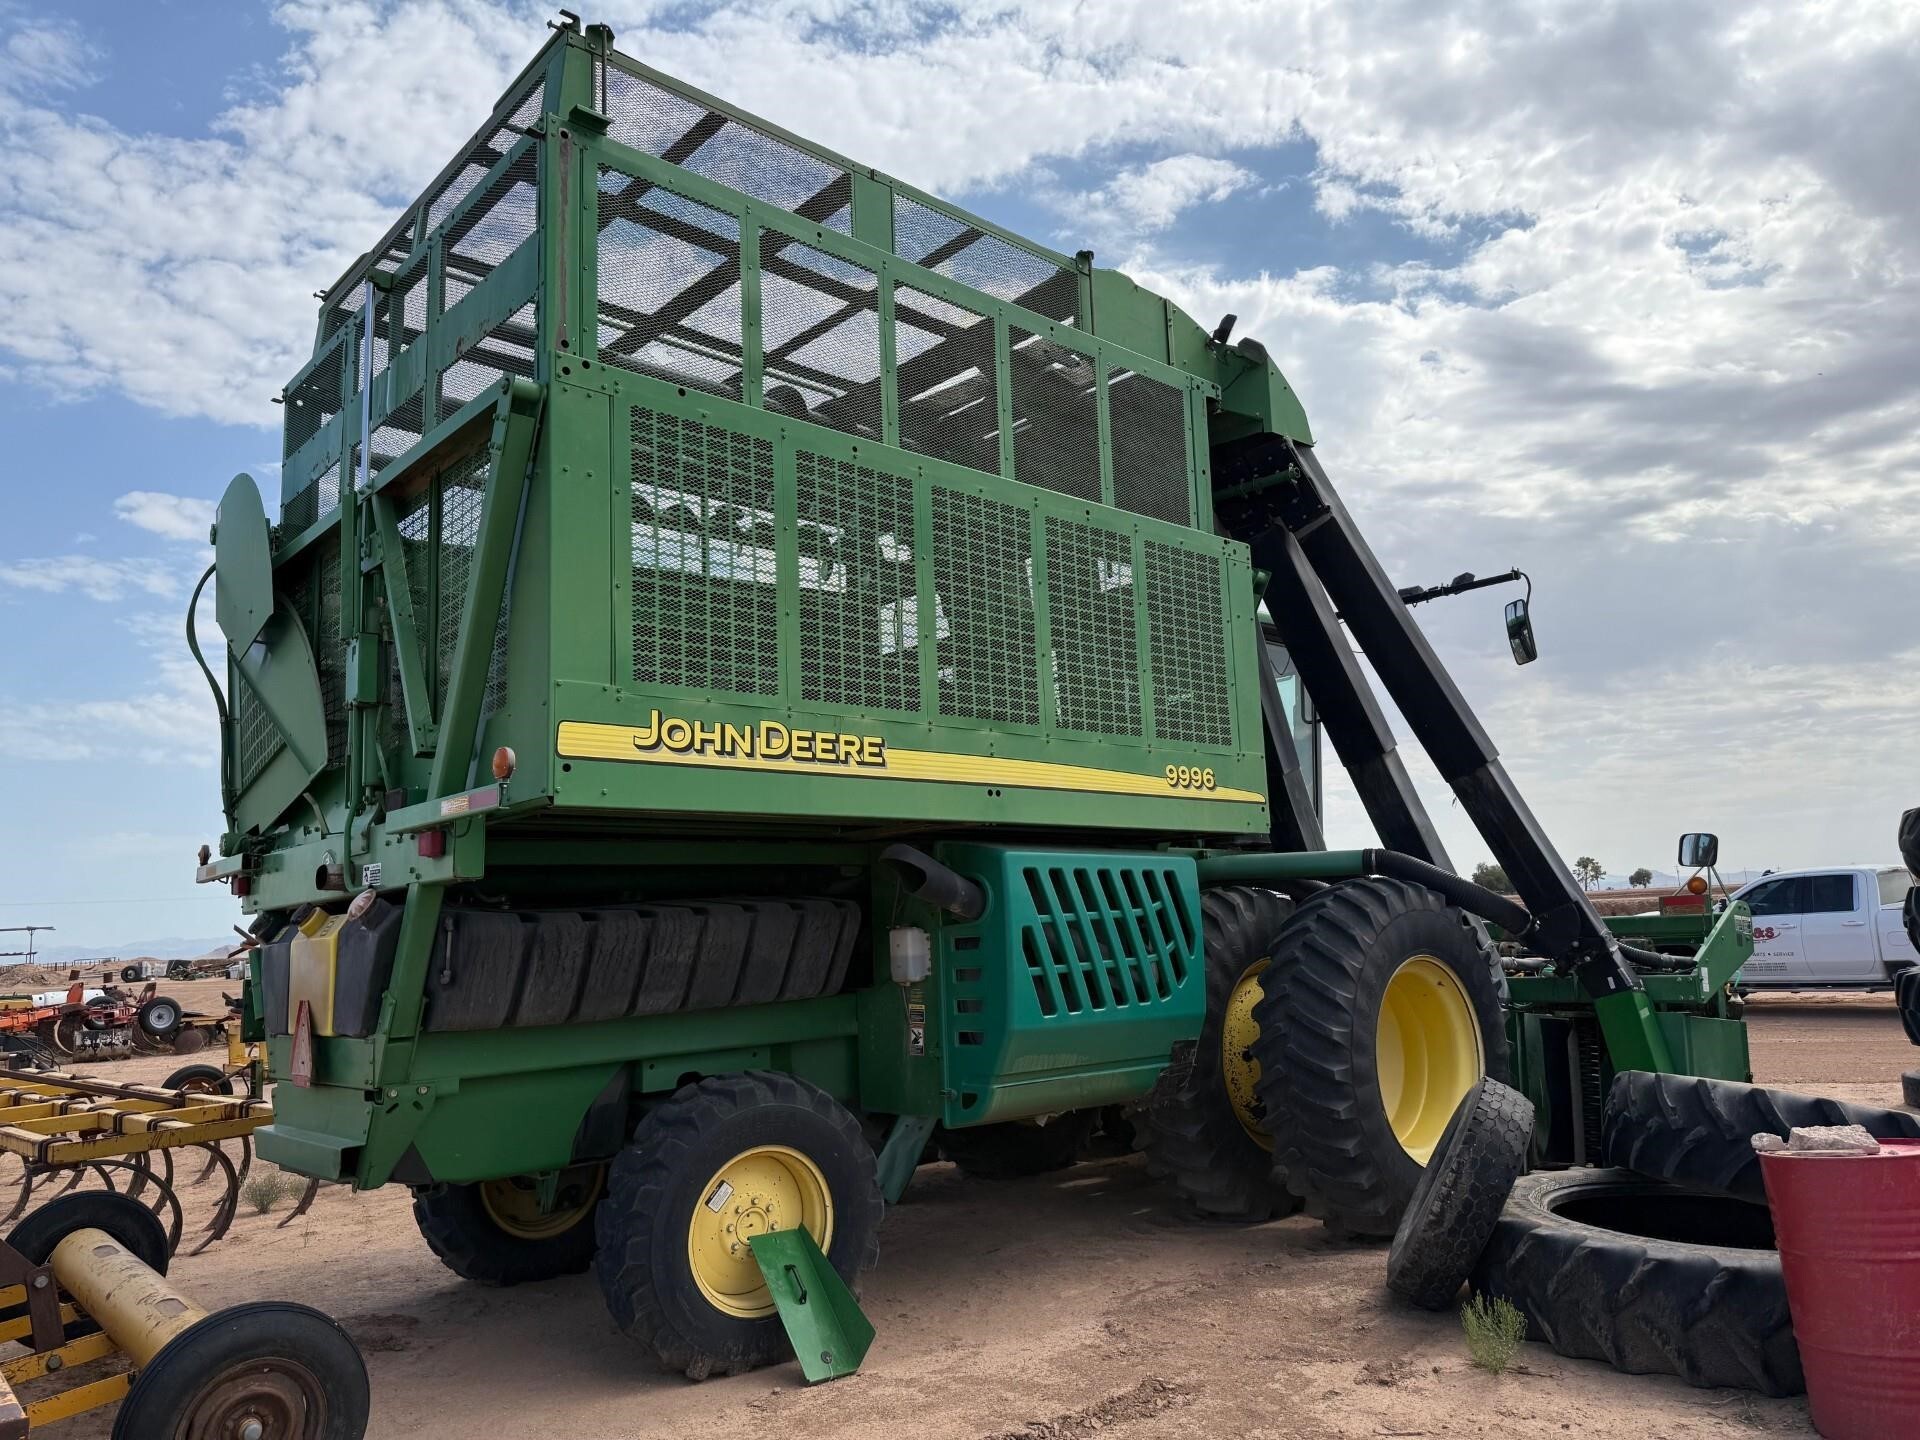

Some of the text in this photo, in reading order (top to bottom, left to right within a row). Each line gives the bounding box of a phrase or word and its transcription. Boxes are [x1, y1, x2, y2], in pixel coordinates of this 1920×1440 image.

[633, 709, 888, 768] JOHN DEERE
[1165, 764, 1216, 791] 9996
